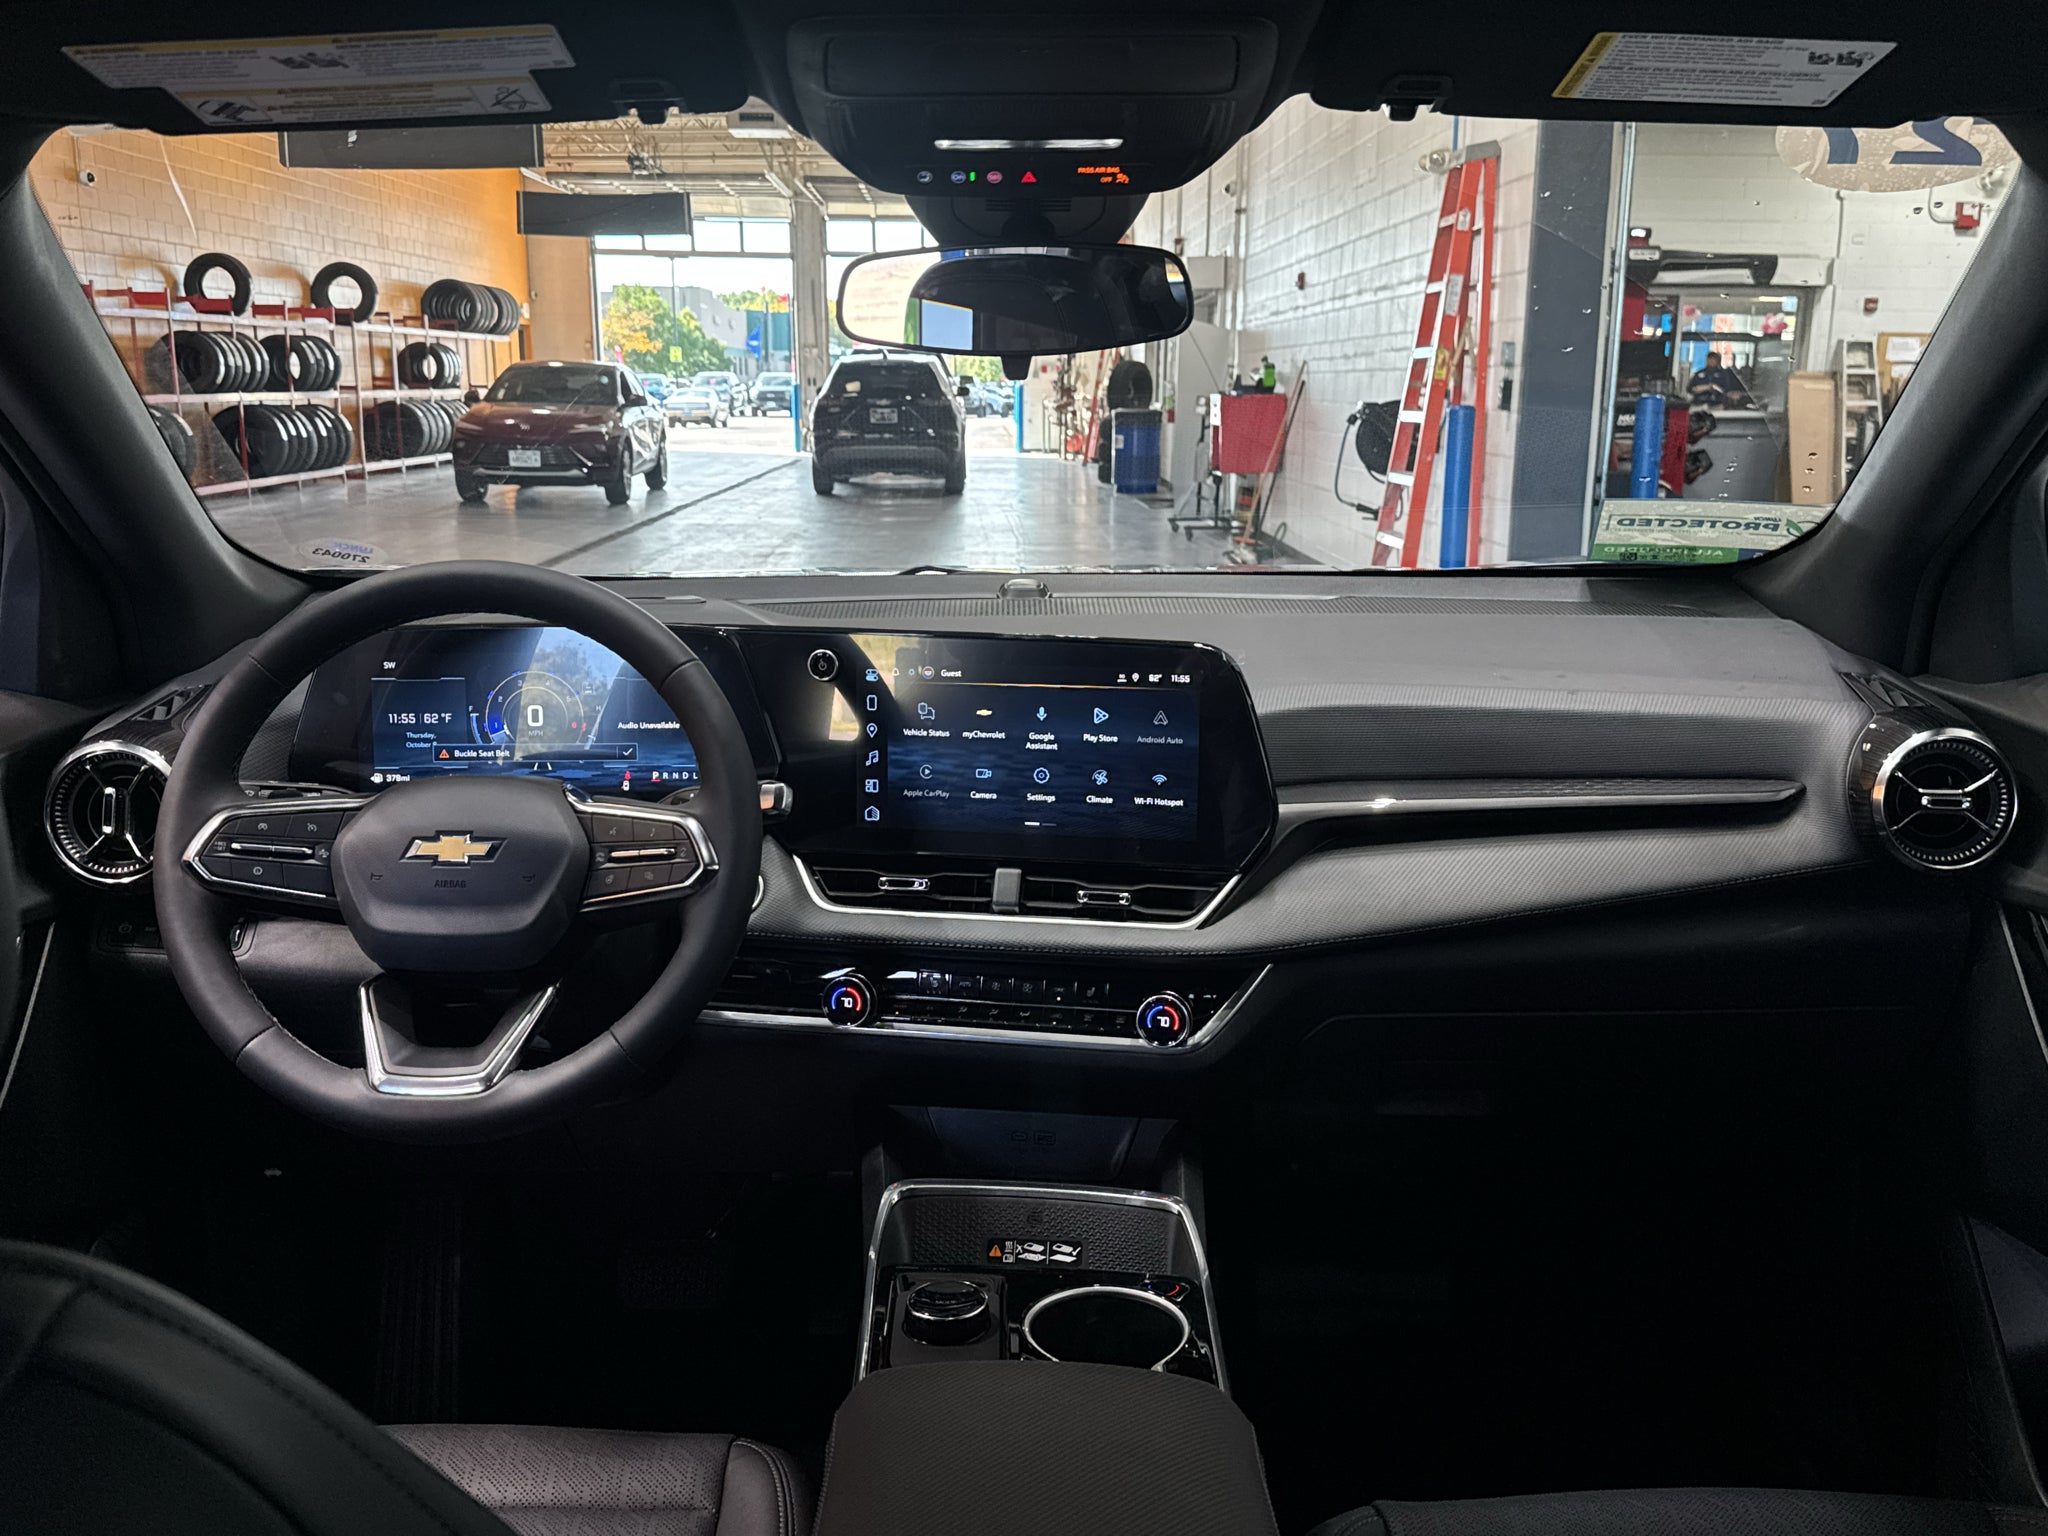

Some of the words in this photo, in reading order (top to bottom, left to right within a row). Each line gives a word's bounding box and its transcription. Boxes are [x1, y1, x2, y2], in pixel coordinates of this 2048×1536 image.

[383, 661, 396, 670] SW
[940, 670, 962, 678] Guest
[1171, 674, 1191, 683] 11:55
[388, 713, 416, 724] 11:55
[424, 713, 439, 724] 62
[527, 704, 544, 727] 0
[406, 732, 436, 740] Thursday,
[903, 728, 926, 737] Vehicle
[928, 729, 950, 738] Status
[962, 730, 1006, 740] myChevrolet
[1028, 732, 1054, 742] Google
[1083, 734, 1099, 744] Play
[1100, 735, 1118, 743] Store
[1136, 736, 1164, 744] Android
[1166, 736, 1184, 744] Auto
[1026, 742, 1058, 750] Assistant
[454, 749, 476, 758] Buckle
[478, 750, 494, 758] Seat
[496, 750, 510, 758] Belt
[652, 771, 660, 780] P
[904, 789, 923, 798] Apple
[924, 790, 950, 800] CarPlay
[970, 791, 997, 800] Camera
[1026, 793, 1056, 802] Settings
[1086, 795, 1114, 804] Climate
[1134, 797, 1152, 806] Wi-Fi
[1153, 798, 1184, 808] Hotspot
[434, 879, 466, 888] AIRBAG
